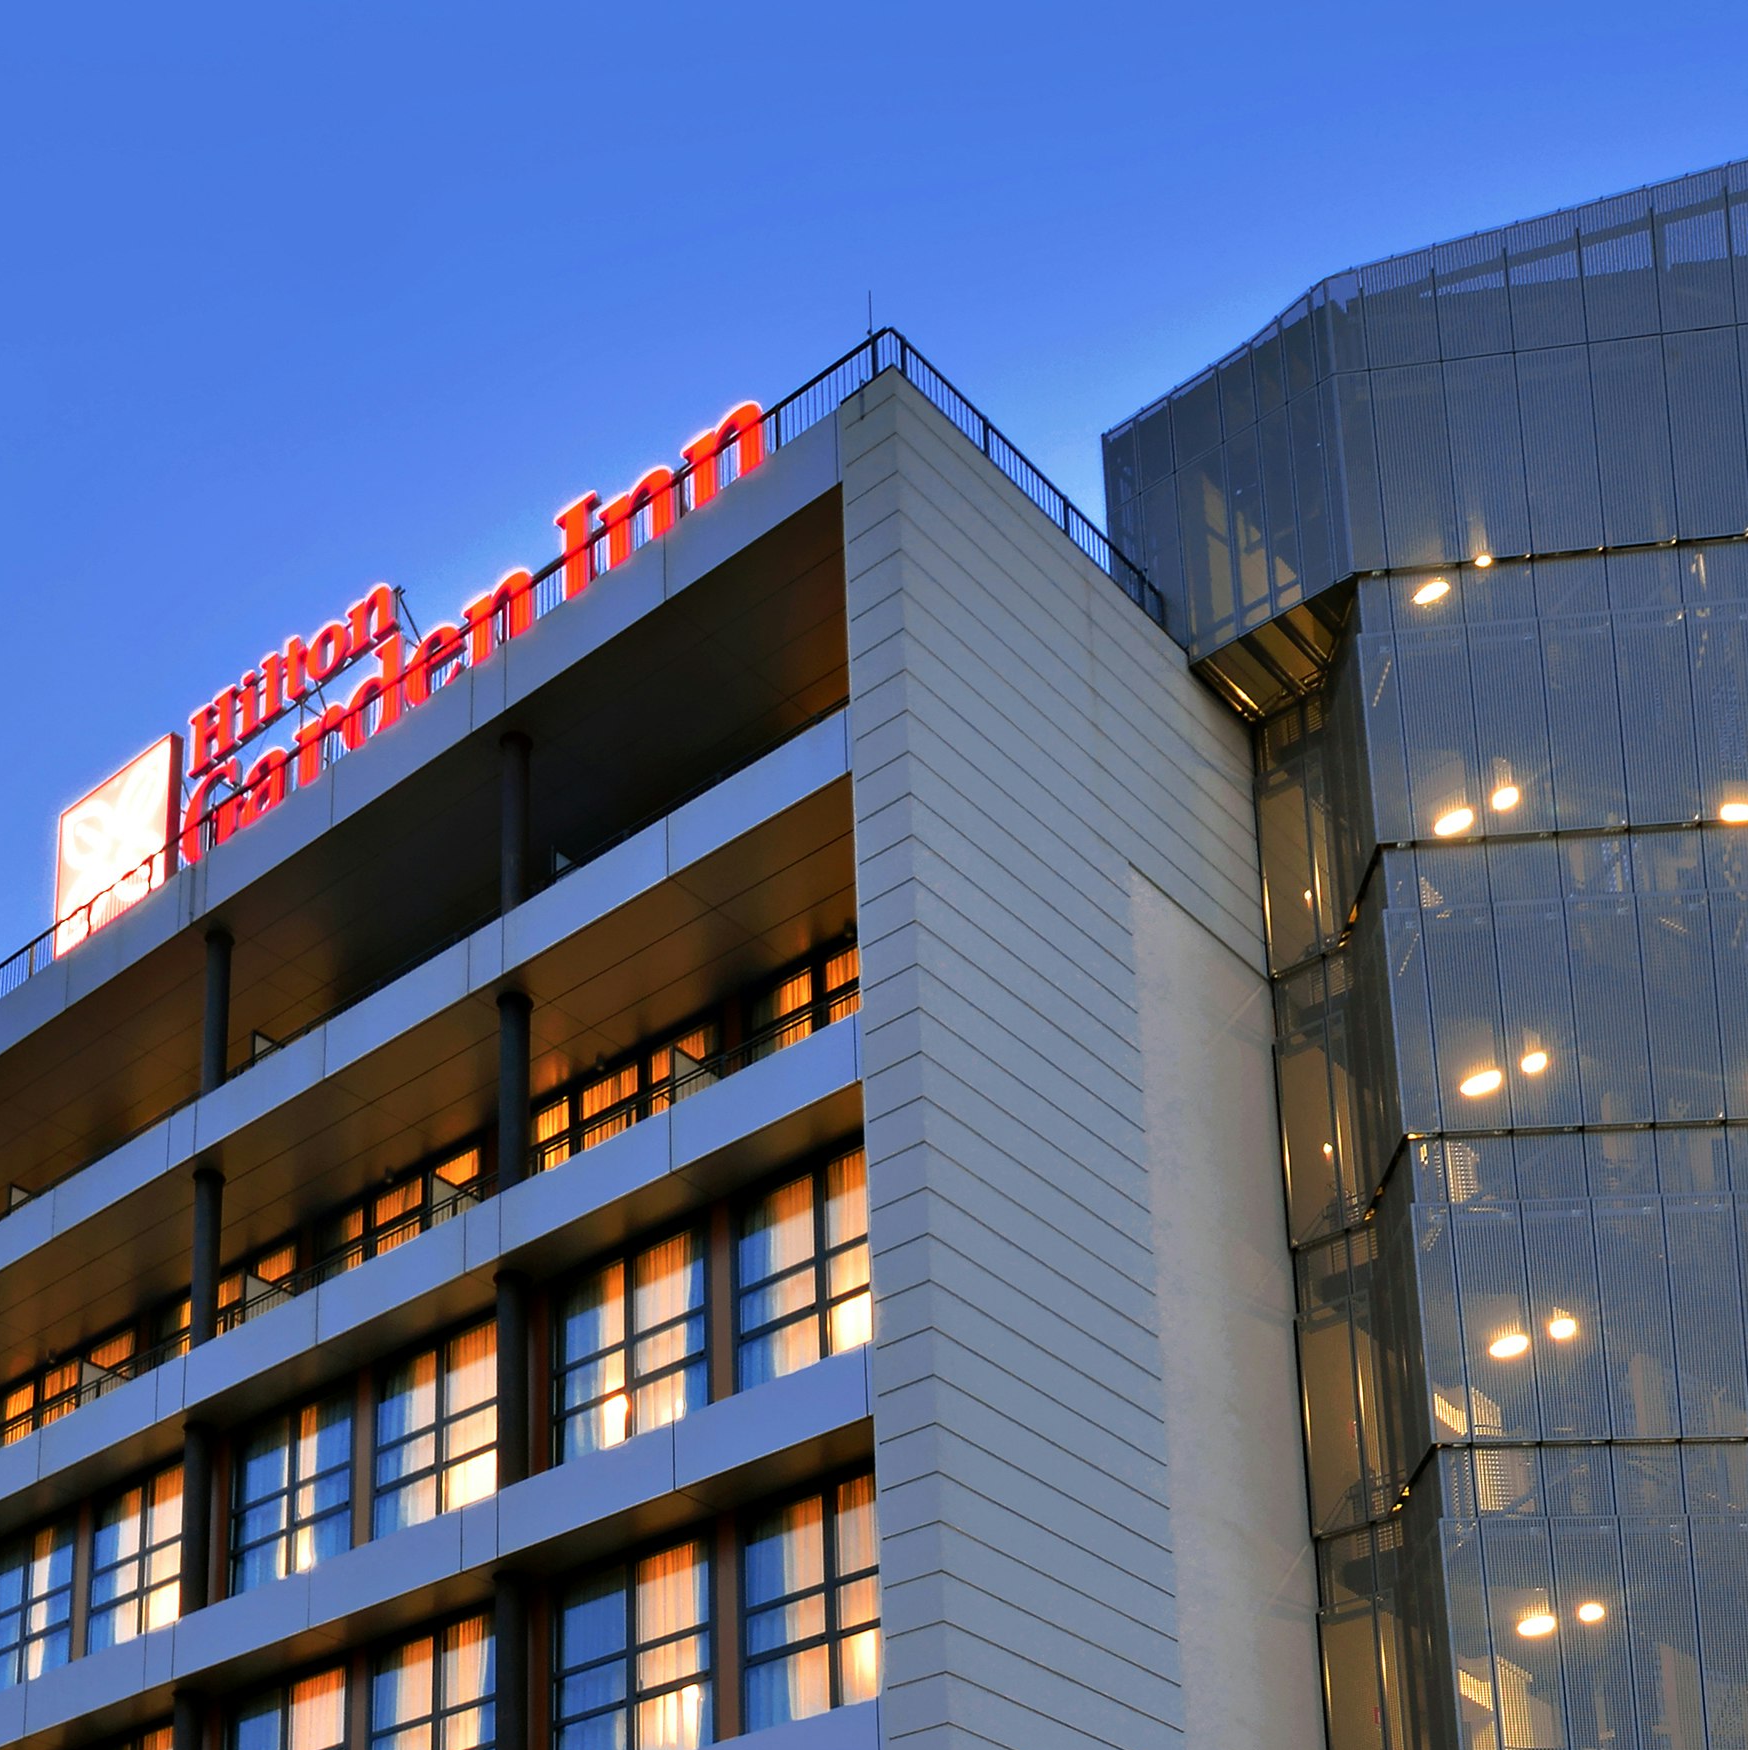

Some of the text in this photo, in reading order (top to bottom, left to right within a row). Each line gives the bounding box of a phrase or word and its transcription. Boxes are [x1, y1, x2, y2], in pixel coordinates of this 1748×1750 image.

[181, 400, 764, 866] Garden Inn
[188, 582, 397, 779] Hilton
